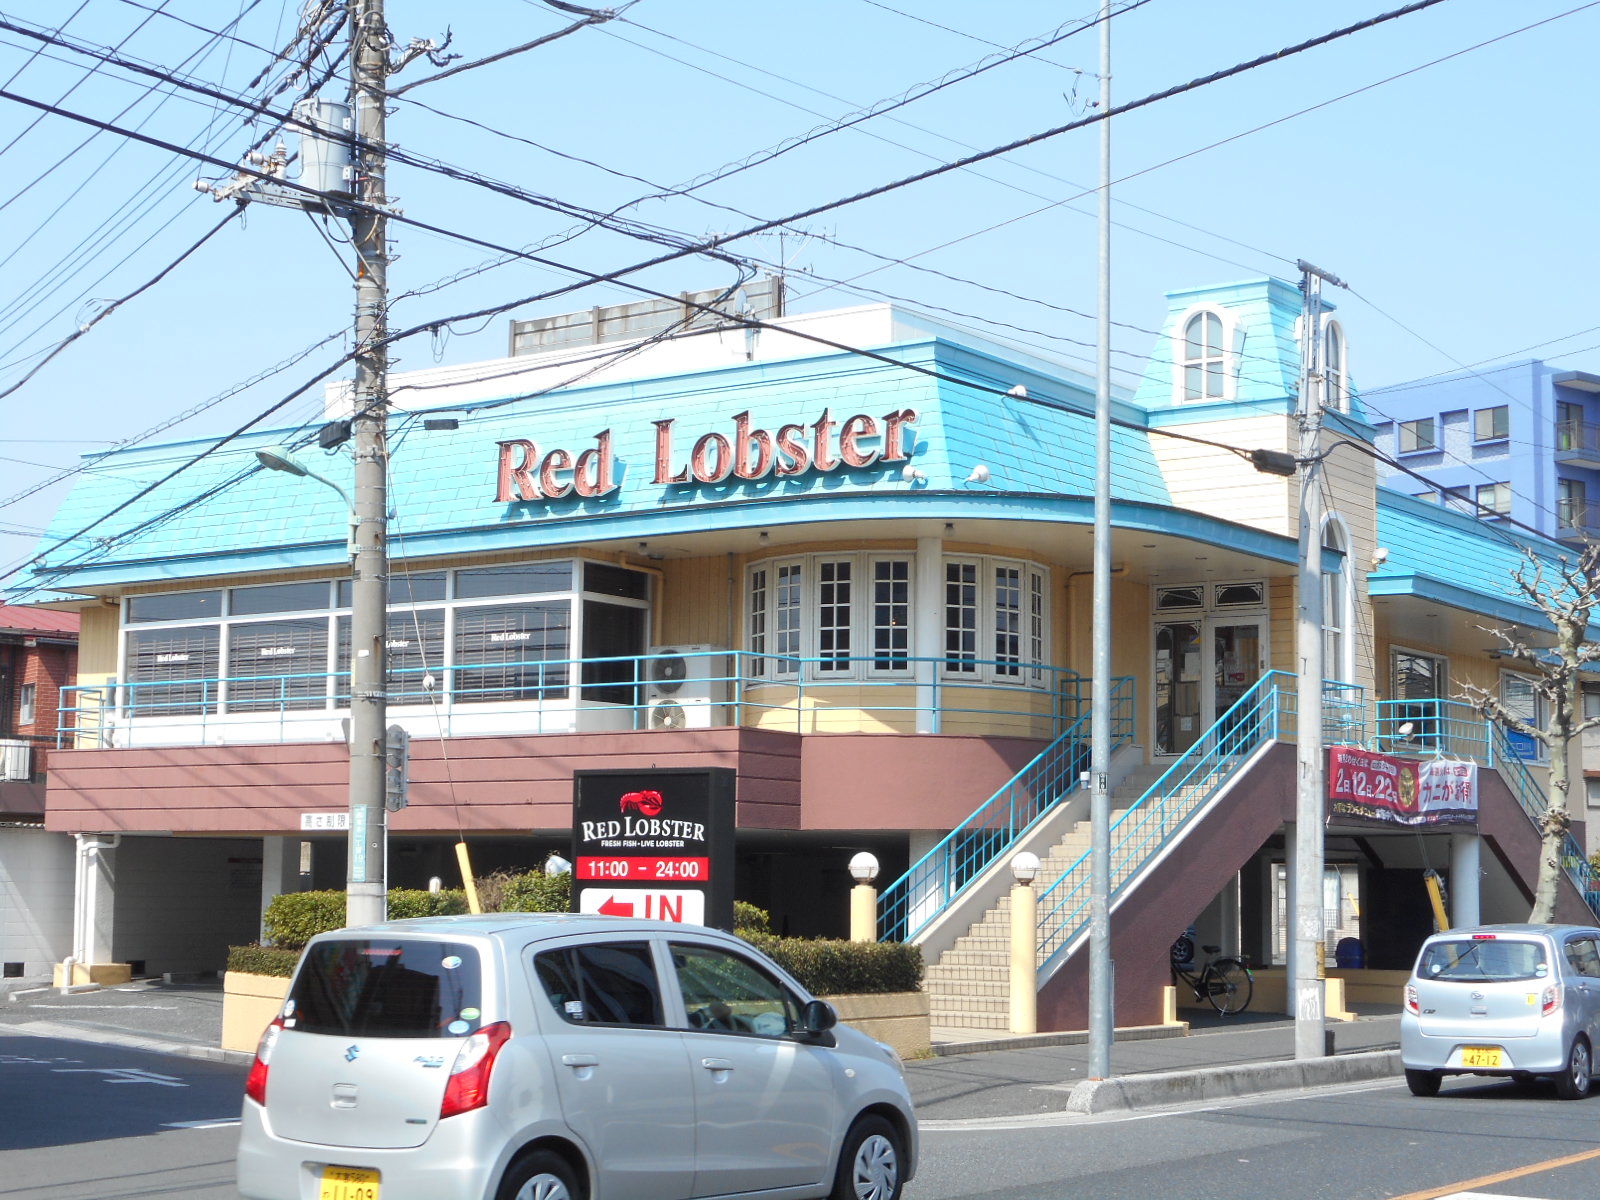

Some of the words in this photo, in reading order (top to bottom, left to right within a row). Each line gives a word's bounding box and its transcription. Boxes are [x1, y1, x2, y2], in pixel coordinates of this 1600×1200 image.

[493, 428, 619, 503] Red
[650, 407, 919, 485] Lobster
[505, 632, 530, 641] Lobster
[582, 820, 620, 842] RED
[624, 816, 705, 841] LOBSTER
[588, 861, 629, 877] 11:00
[655, 861, 699, 877] 24:00
[645, 896, 682, 923] IN
